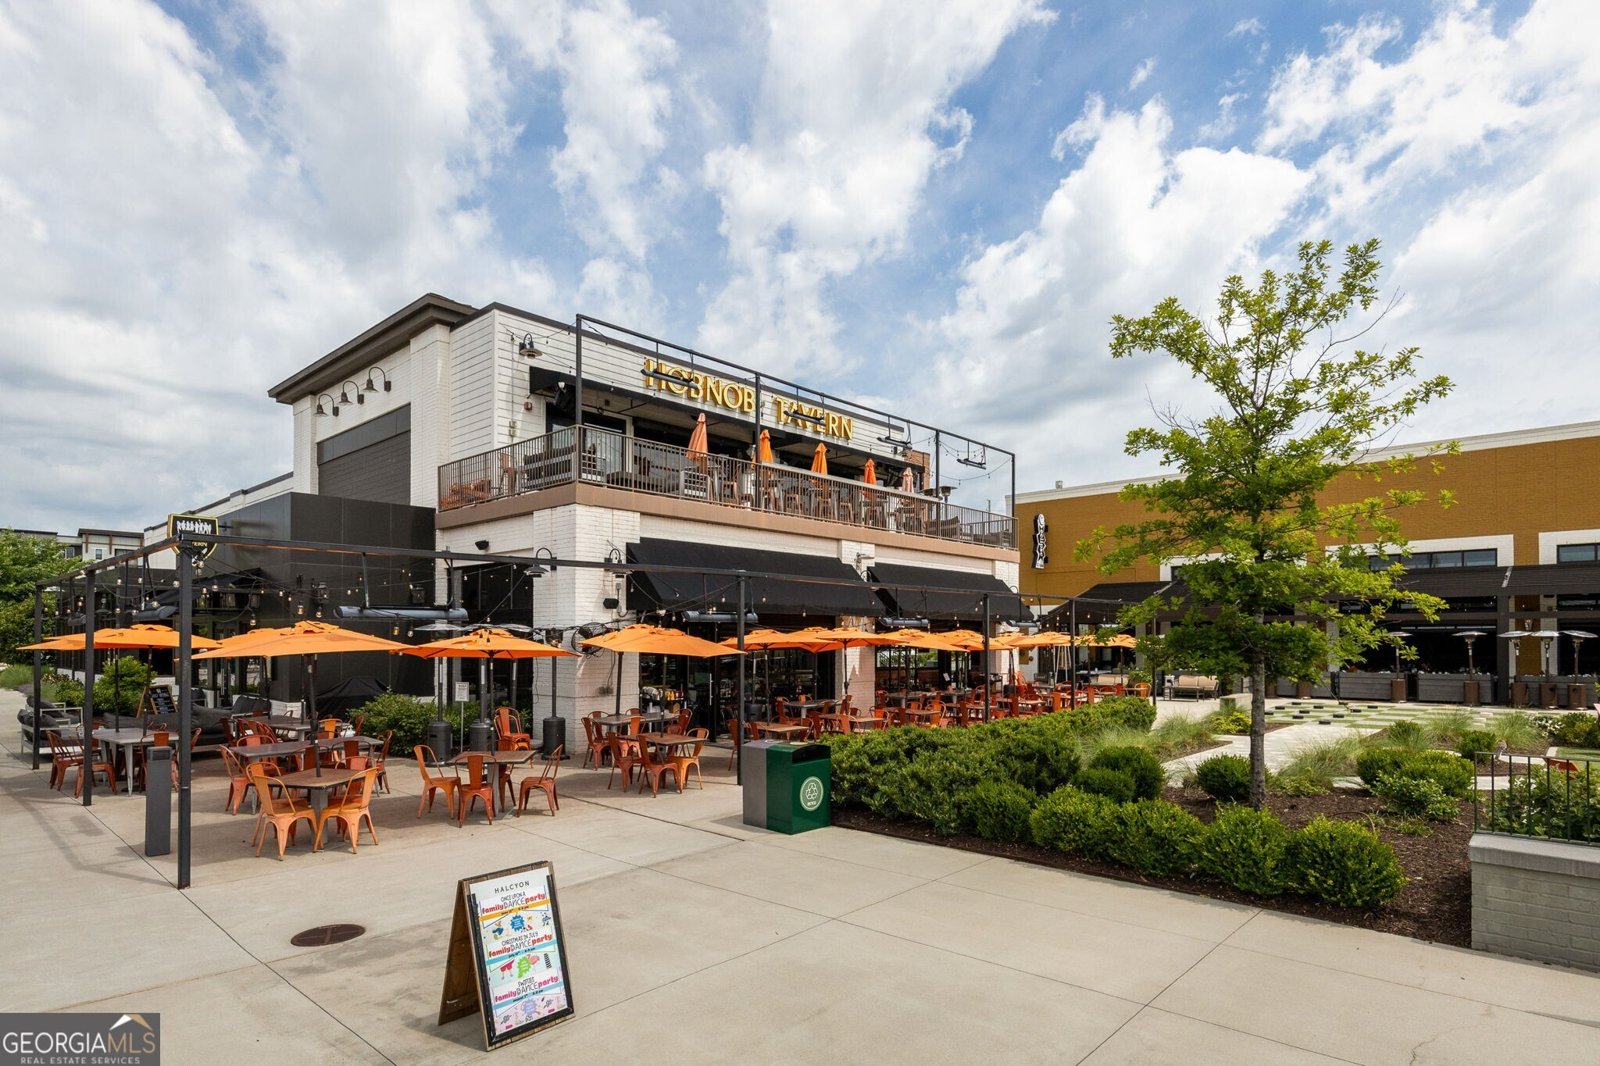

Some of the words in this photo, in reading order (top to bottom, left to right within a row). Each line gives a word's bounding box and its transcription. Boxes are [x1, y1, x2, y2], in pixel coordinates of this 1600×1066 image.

[643, 357, 755, 413] HOBNOB
[773, 396, 853, 440] TAVERN
[494, 880, 530, 894] HALCYON
